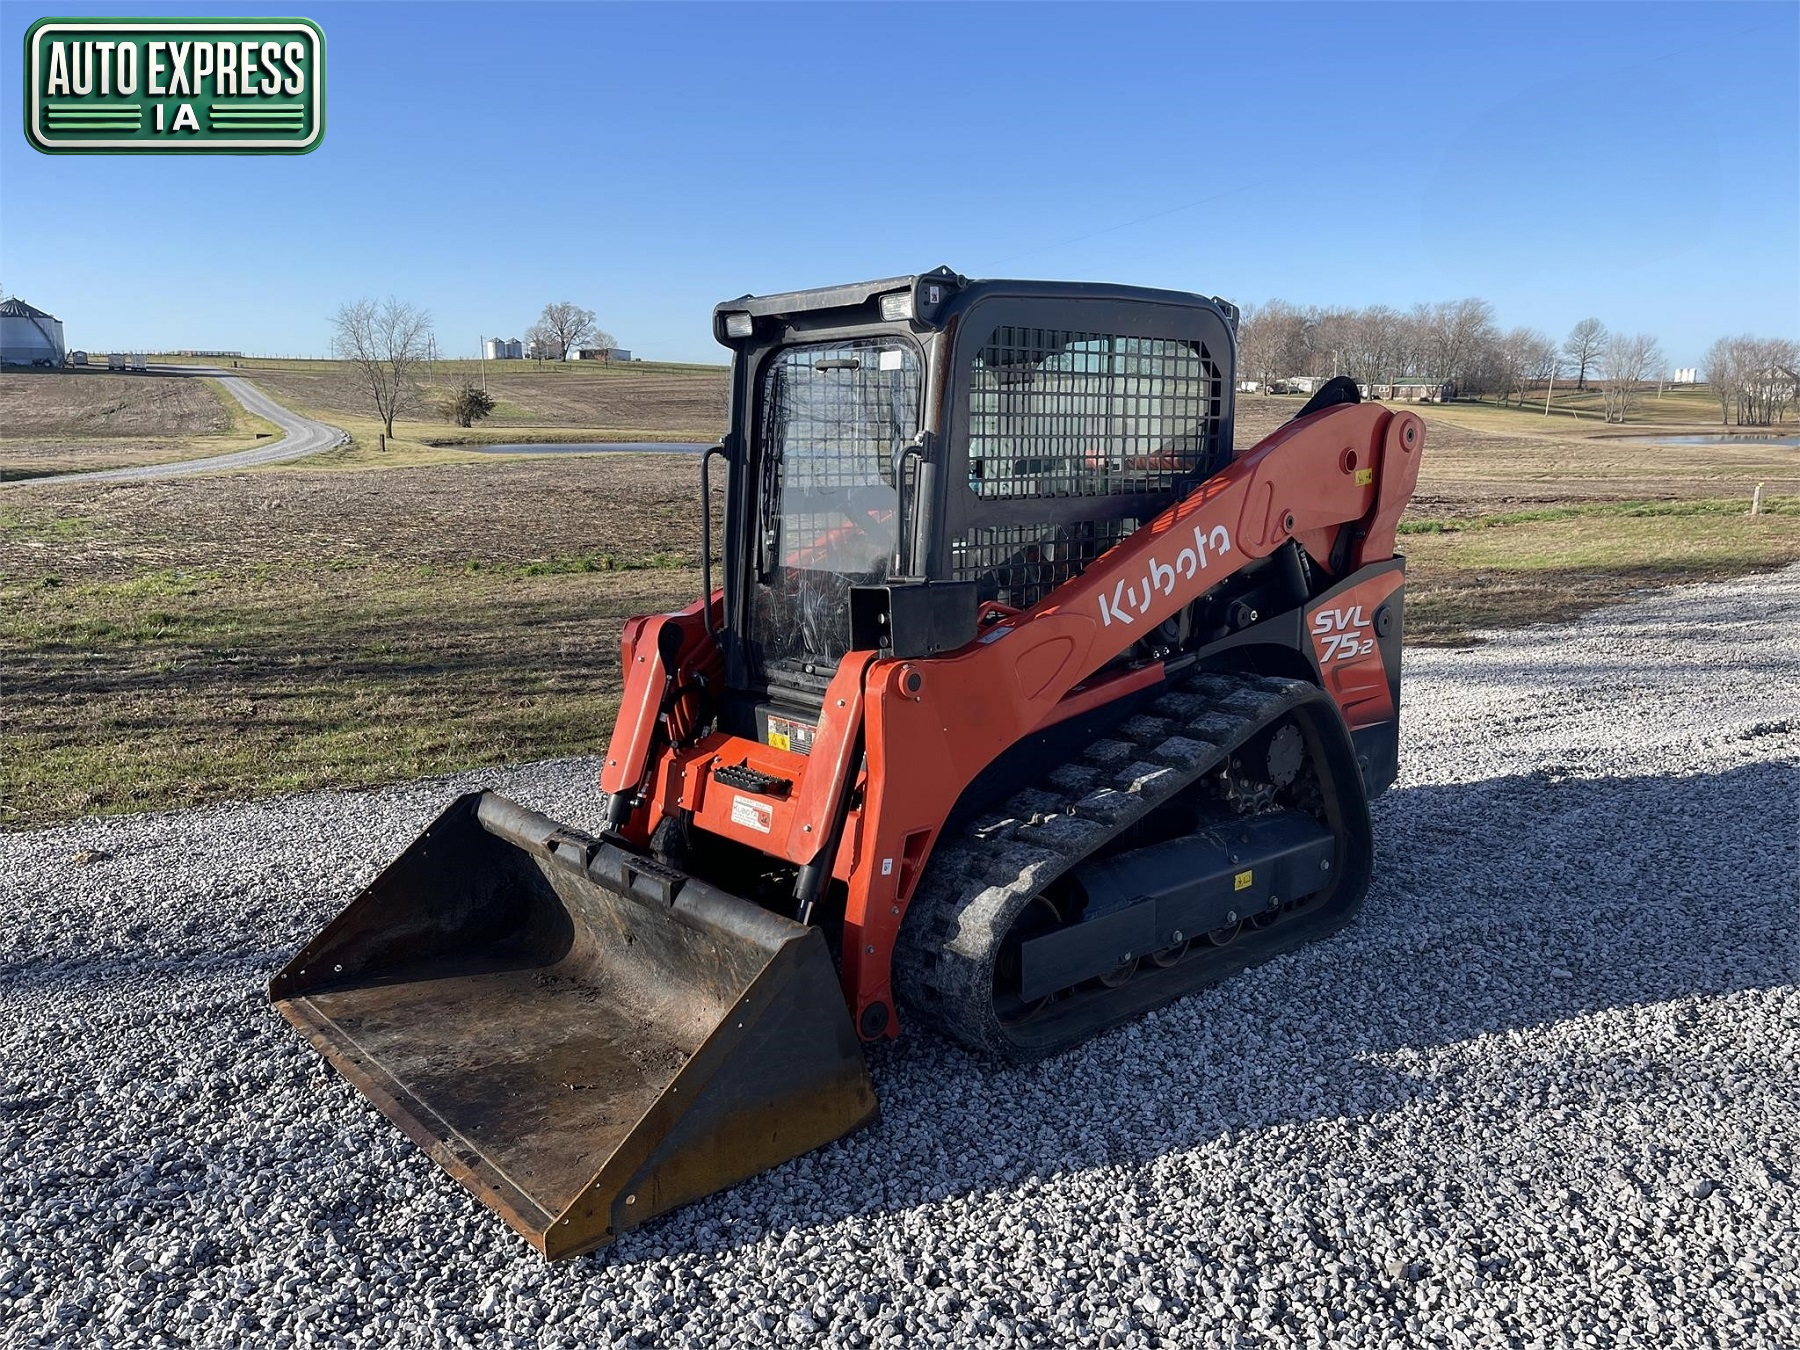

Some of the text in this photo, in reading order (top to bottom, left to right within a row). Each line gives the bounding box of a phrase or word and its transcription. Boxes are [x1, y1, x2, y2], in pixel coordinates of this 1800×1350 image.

[1098, 525, 1231, 627] Kubota
[1311, 606, 1371, 635] SVL
[1320, 631, 1374, 663] 75-2
